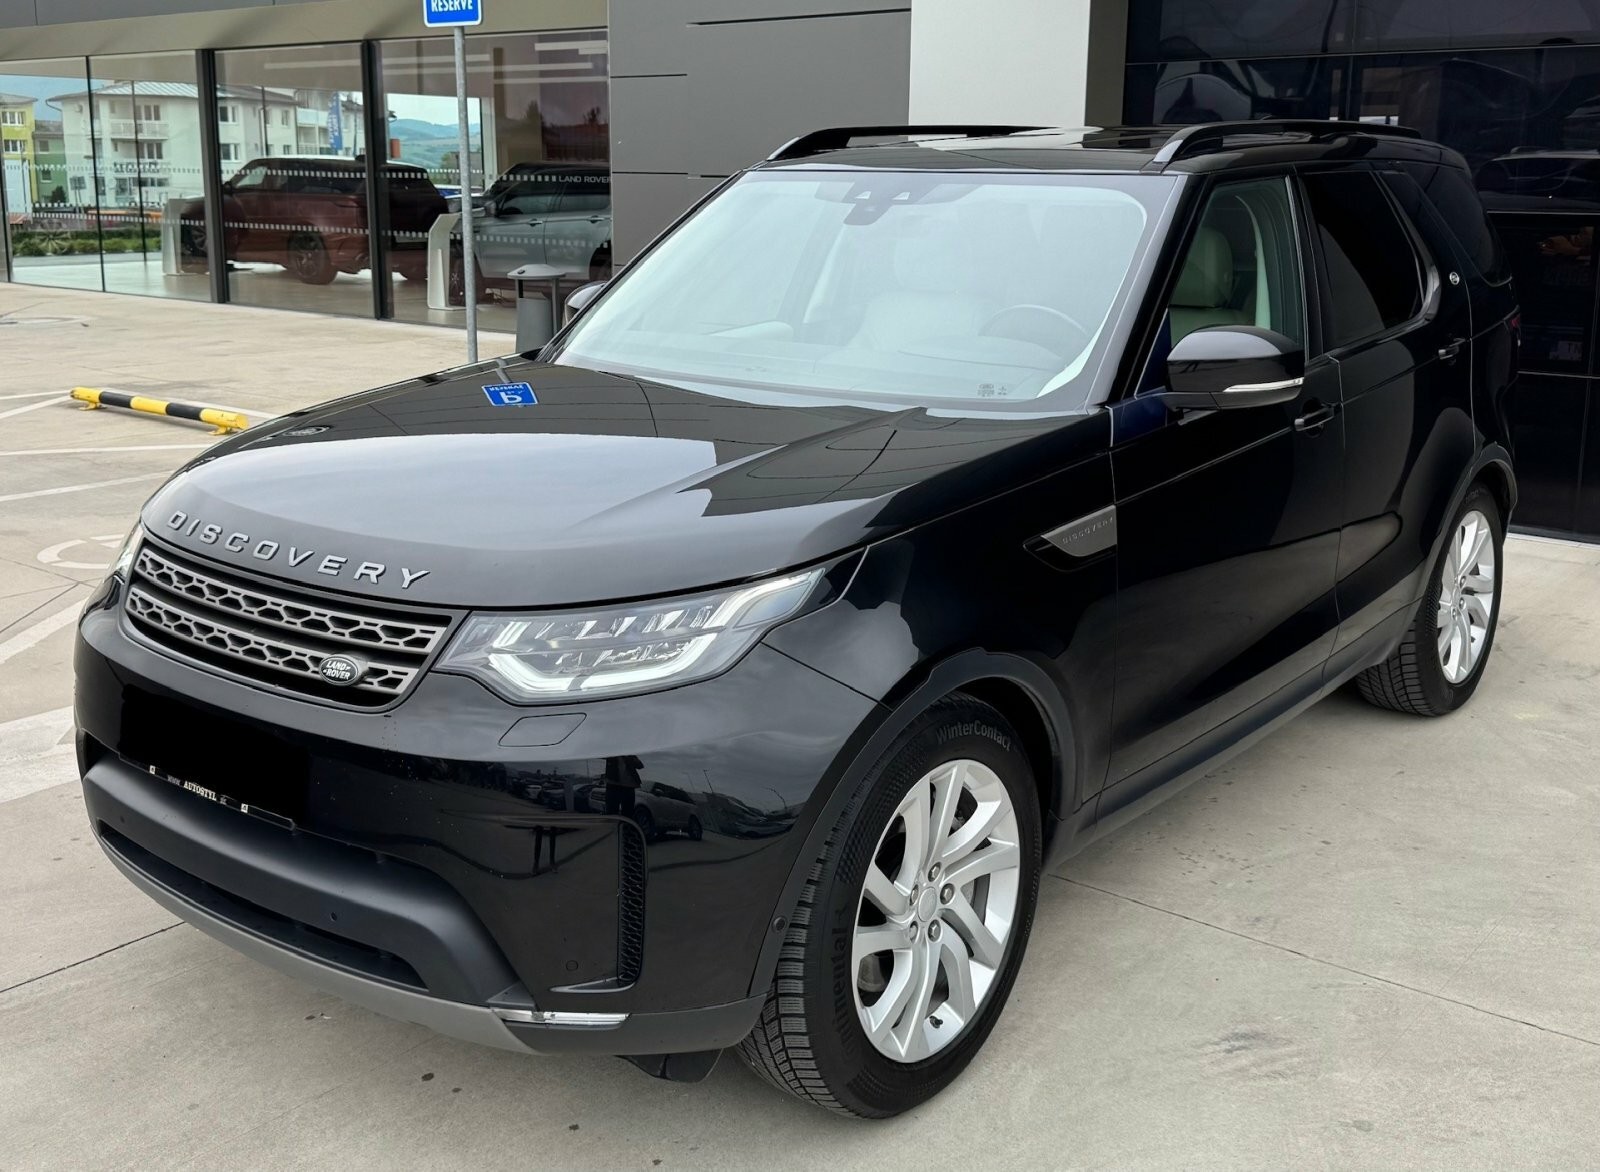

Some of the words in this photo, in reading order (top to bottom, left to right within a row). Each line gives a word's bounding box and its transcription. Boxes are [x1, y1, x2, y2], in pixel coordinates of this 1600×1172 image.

[559, 175, 582, 183] LAND
[167, 510, 431, 590] DISCOVERY
[326, 660, 347, 671] LAND
[326, 668, 351, 680] ROVER
[936, 720, 1011, 752] WinterContact
[183, 780, 217, 802] AUTOSTYL
